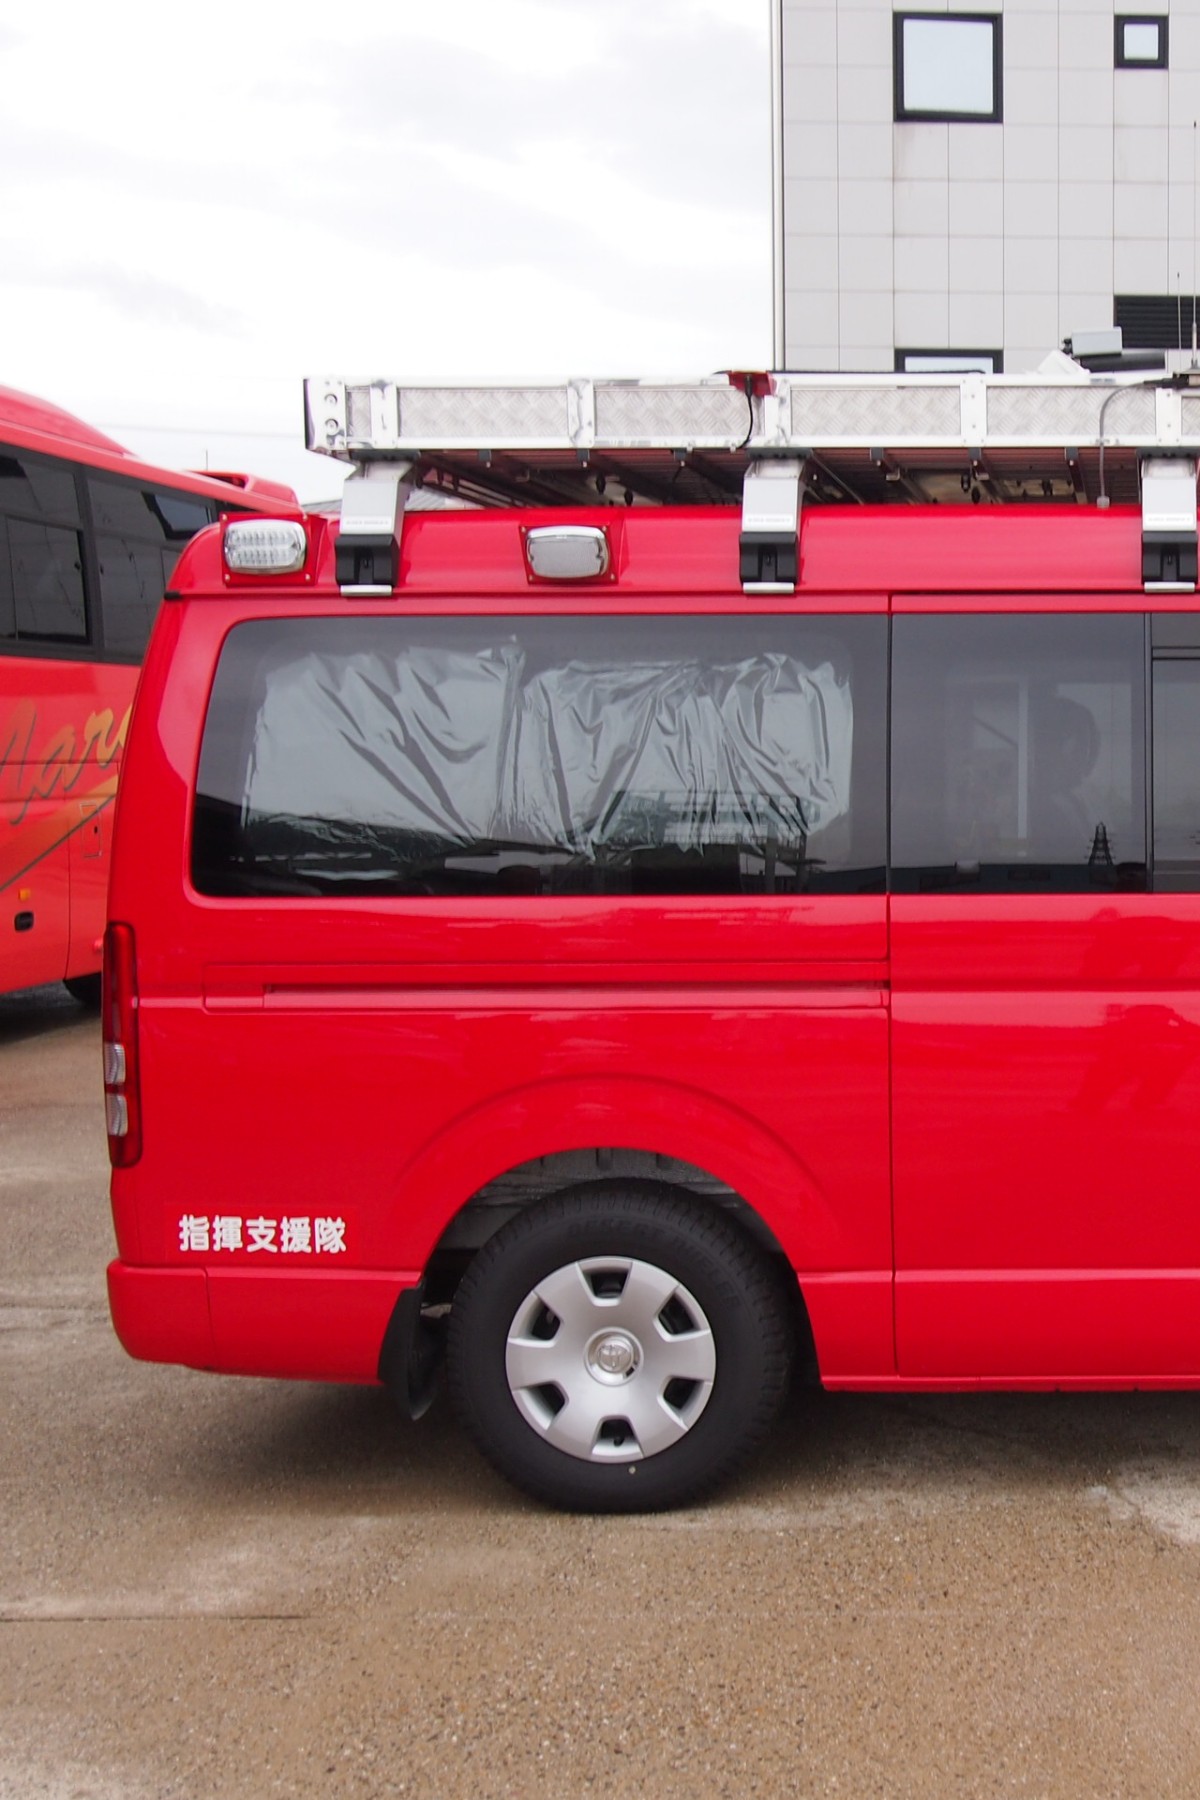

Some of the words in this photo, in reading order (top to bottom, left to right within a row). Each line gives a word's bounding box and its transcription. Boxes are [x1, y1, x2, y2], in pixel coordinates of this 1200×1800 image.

[178, 1214, 347, 1254] 指揮支援隊
